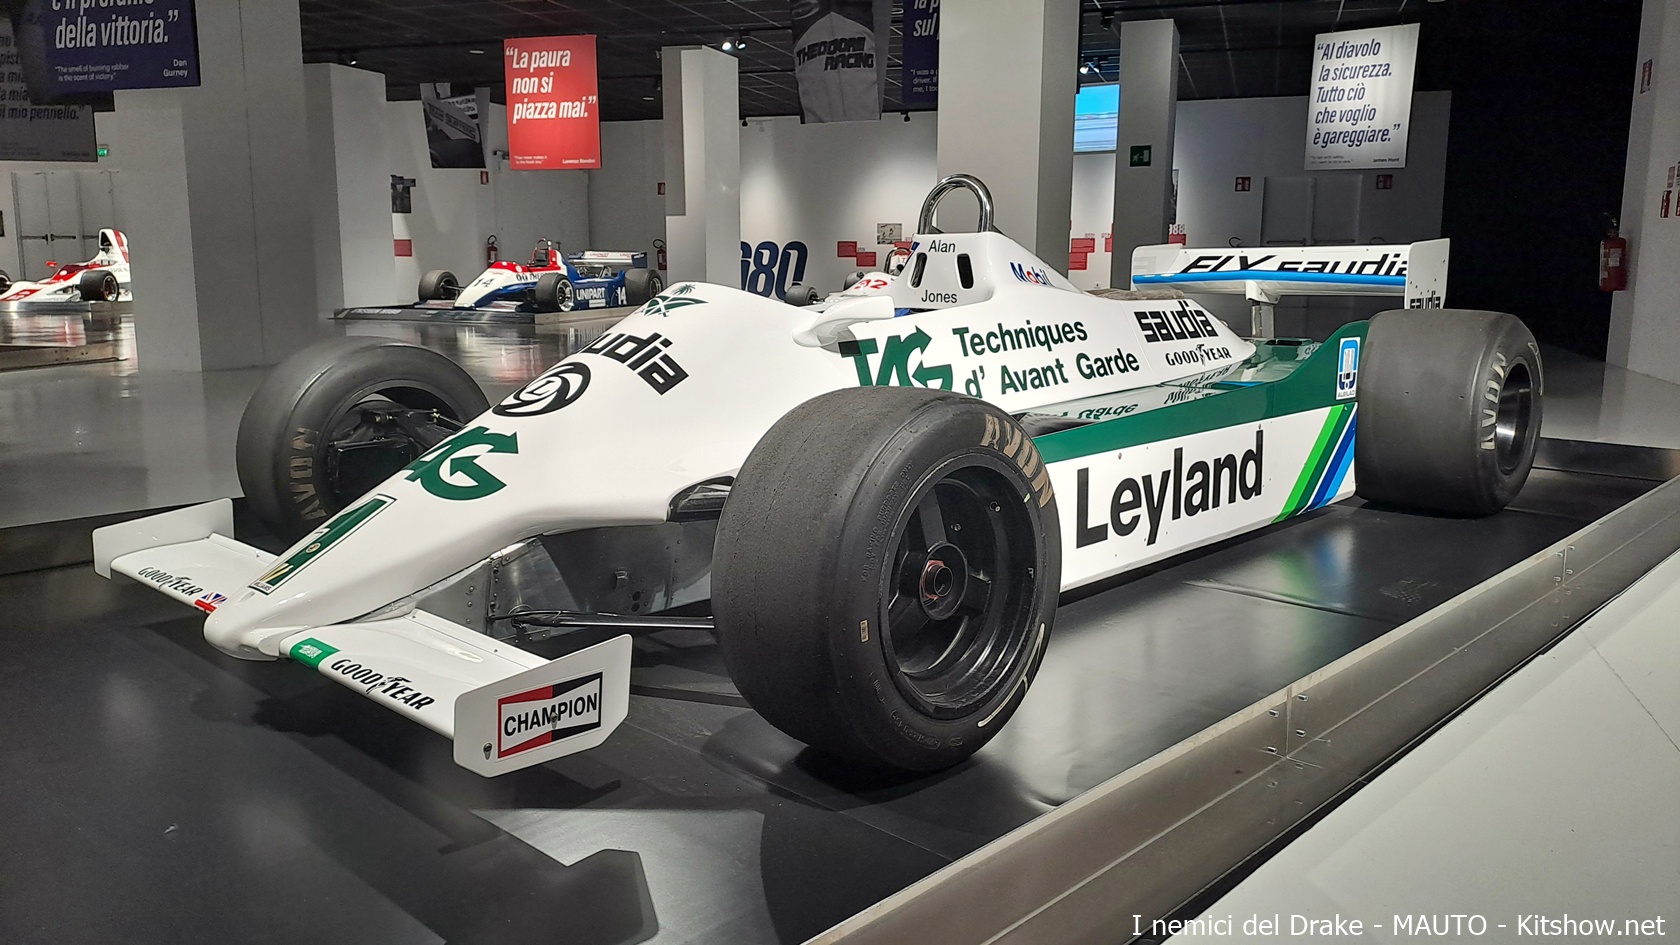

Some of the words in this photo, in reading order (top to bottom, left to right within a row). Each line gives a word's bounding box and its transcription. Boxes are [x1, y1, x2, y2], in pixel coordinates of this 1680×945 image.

[55, 15, 97, 49] della
[506, 47, 529, 68] “La
[530, 49, 571, 73] paura
[1335, 38, 1381, 60] diavolo
[163, 68, 188, 77] Gurney
[173, 59, 187, 67] Dan
[824, 52, 875, 71] RACING
[1318, 64, 1331, 82] la
[1331, 62, 1392, 81] sicurezza.
[512, 77, 539, 94] non
[540, 71, 554, 93] si
[1316, 86, 1345, 103] Tutto
[1347, 82, 1366, 101] ciò
[8, 106, 28, 119] mio
[512, 97, 557, 124] piazza
[559, 96, 596, 118] mai.”
[1314, 106, 1336, 124] che
[1338, 104, 1377, 126] voglio
[1312, 127, 1321, 145] è
[928, 238, 956, 253] Alan
[473, 278, 495, 287] 14
[1009, 262, 1056, 288] Mobil
[576, 287, 606, 300] UNIPART
[617, 286, 627, 305] 14
[921, 289, 957, 304] Jones
[1134, 300, 1219, 343] saudia
[953, 318, 1088, 357] Techniques
[1001, 357, 1068, 395] Avant
[1076, 348, 1140, 381] Garde
[1480, 351, 1508, 450] AVON
[980, 413, 1054, 508] AVON
[289, 427, 328, 521] AVON
[1076, 429, 1264, 549] Leyland
[503, 692, 598, 737] CHAMPION
